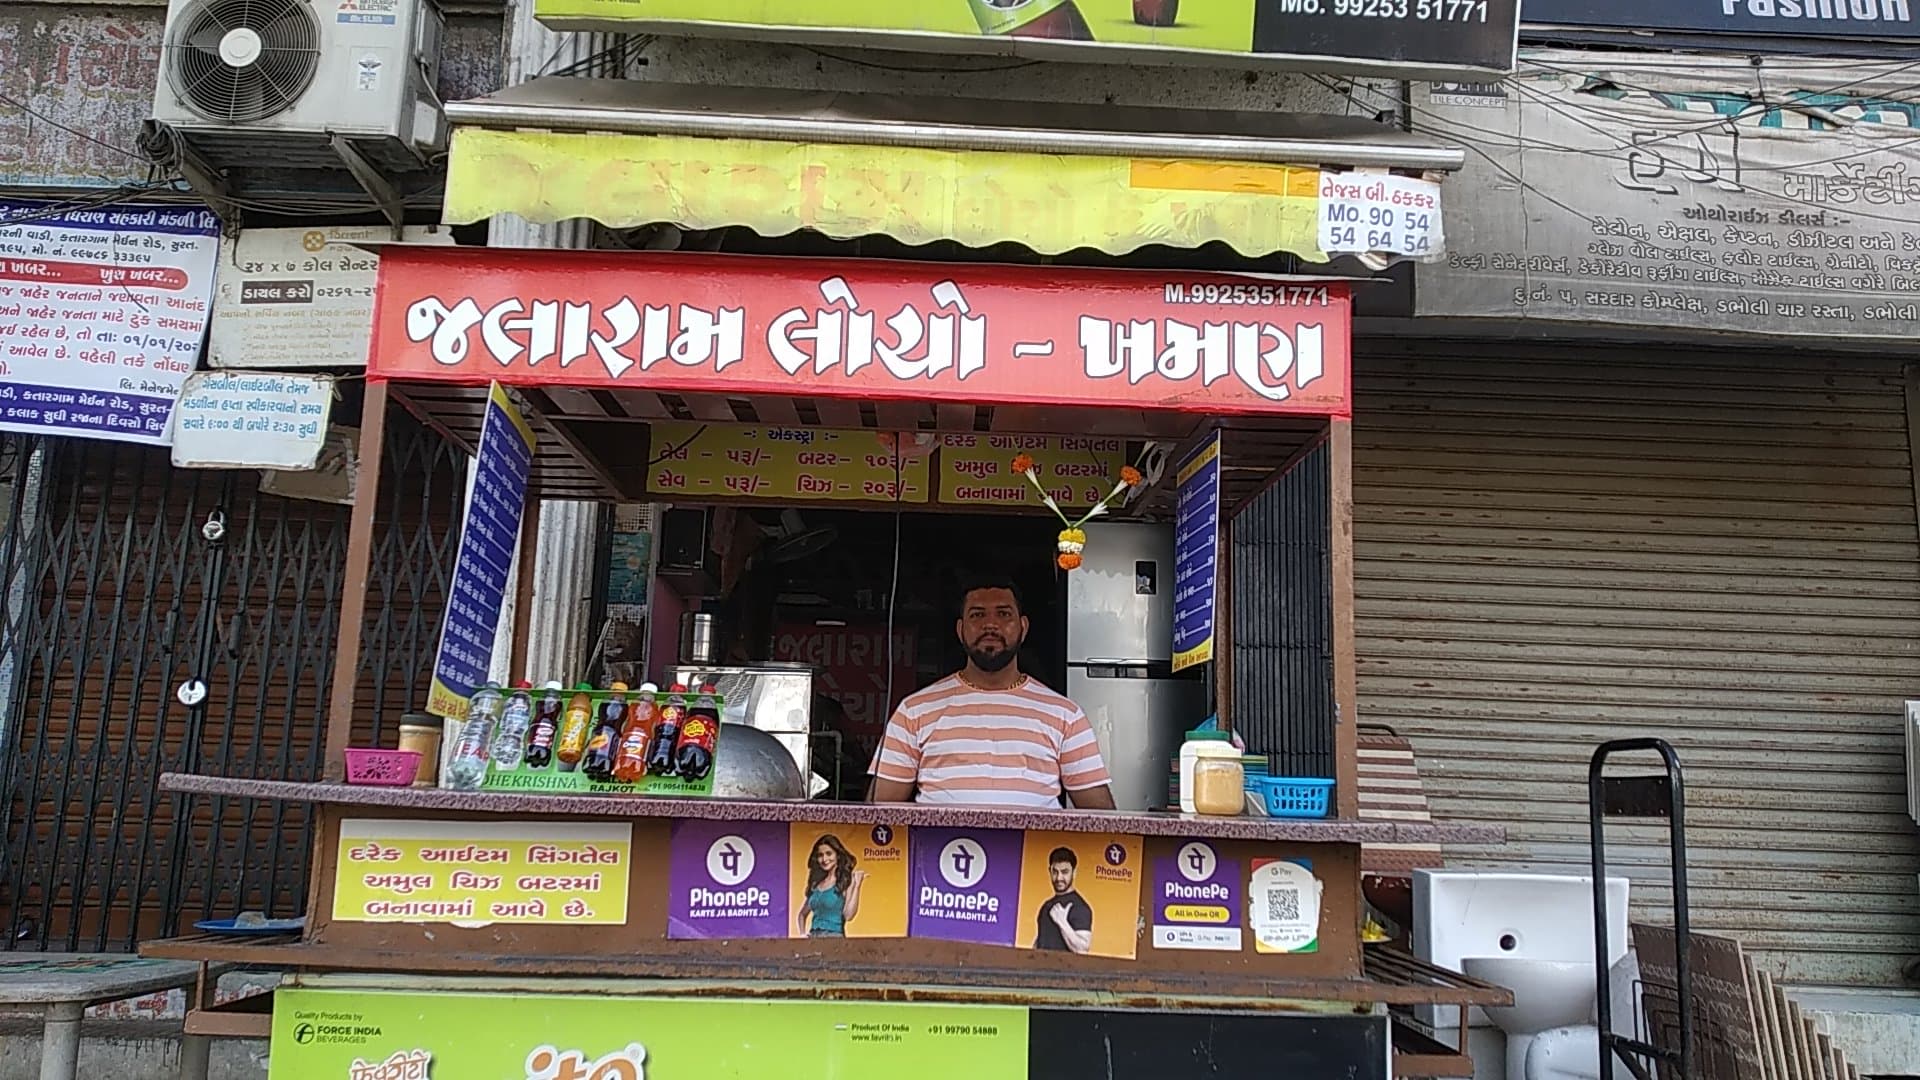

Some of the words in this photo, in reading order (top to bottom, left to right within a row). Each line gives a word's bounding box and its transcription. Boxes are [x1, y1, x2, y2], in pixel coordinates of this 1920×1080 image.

[1334, 0, 1408, 17] 99253
[1416, 0, 1488, 23] 51771
[1322, 177, 1361, 199] તેજસ
[1365, 182, 1389, 202] બી.
[1392, 189, 1434, 209] ઠકકર
[109, 210, 156, 226] સહકારી
[158, 210, 195, 228] મંડળી
[1328, 204, 1364, 223] Mo.
[1369, 207, 1394, 227] 90
[1405, 212, 1429, 232] 54
[27, 228, 54, 243] વાડી,
[60, 233, 108, 246] કતારગામ
[143, 235, 165, 250] રોડ,
[1331, 227, 1355, 245] 54
[1368, 230, 1392, 248] 64
[1404, 235, 1430, 253] 54
[1860, 232, 1895, 250] અને
[303, 257, 332, 271] કોલ
[339, 256, 378, 271] સેન્ટર
[56, 289, 102, 303] જનતાને
[166, 296, 205, 312] આનંદ
[243, 287, 281, 299] ડાયલ
[286, 284, 311, 299] કરો
[1164, 282, 1329, 307] M.9925351771
[62, 309, 97, 322] જનતા
[102, 308, 124, 322] માટે
[1585, 292, 1635, 307] સરદાર
[1717, 296, 1769, 315] ડભોલી
[1776, 303, 1805, 317] ચાર
[1863, 302, 1917, 321] ડભોલી
[21, 325, 49, 339] રહેલ
[77, 326, 91, 341] તો
[406, 295, 744, 380] જલારામ
[767, 275, 986, 380] લોચો
[1079, 314, 1324, 401] ખમણ
[9, 343, 48, 358] આવેલ
[79, 350, 115, 365] વહેલી
[123, 353, 145, 368] તકે
[23, 391, 74, 405] કતારગામ
[109, 395, 133, 411] રોડ,
[8, 408, 39, 420] કલાક
[43, 409, 66, 424] સુધી
[954, 460, 998, 479] અમુલ
[956, 485, 1025, 501] બનાવામાં
[589, 784, 636, 794] RAJKOT
[350, 844, 402, 862] દરેક
[420, 846, 508, 863] આઈટમ
[528, 846, 619, 865] સિંગતેલ
[864, 848, 901, 857] PhonePe
[1096, 865, 1133, 878] PhonePe
[365, 874, 432, 893] અમુલ
[451, 872, 499, 891] ચિઝ
[518, 873, 600, 891] બટરમાં
[1165, 882, 1229, 900] PhonePe
[690, 888, 770, 907] PhonePe
[920, 886, 999, 912] PhonePe
[366, 899, 472, 917] બનાવામાં
[491, 900, 544, 917] આવે
[564, 900, 593, 917] છે.
[690, 909, 715, 918] KARTE
[716, 909, 726, 917] JA
[727, 908, 757, 917] BADHTE
[759, 908, 769, 917] JA
[919, 907, 944, 918] KARTE
[944, 910, 955, 919] JA
[956, 911, 986, 922] BADHTE
[987, 914, 998, 923] JA
[1174, 909, 1186, 918] All
[321, 1012, 352, 1020] Products
[318, 1026, 352, 1035] FORCE
[354, 1027, 382, 1036] INDIA
[851, 1023, 880, 1031] Product
[928, 1025, 943, 1034] +91
[317, 1035, 367, 1044] BEVERAGES
